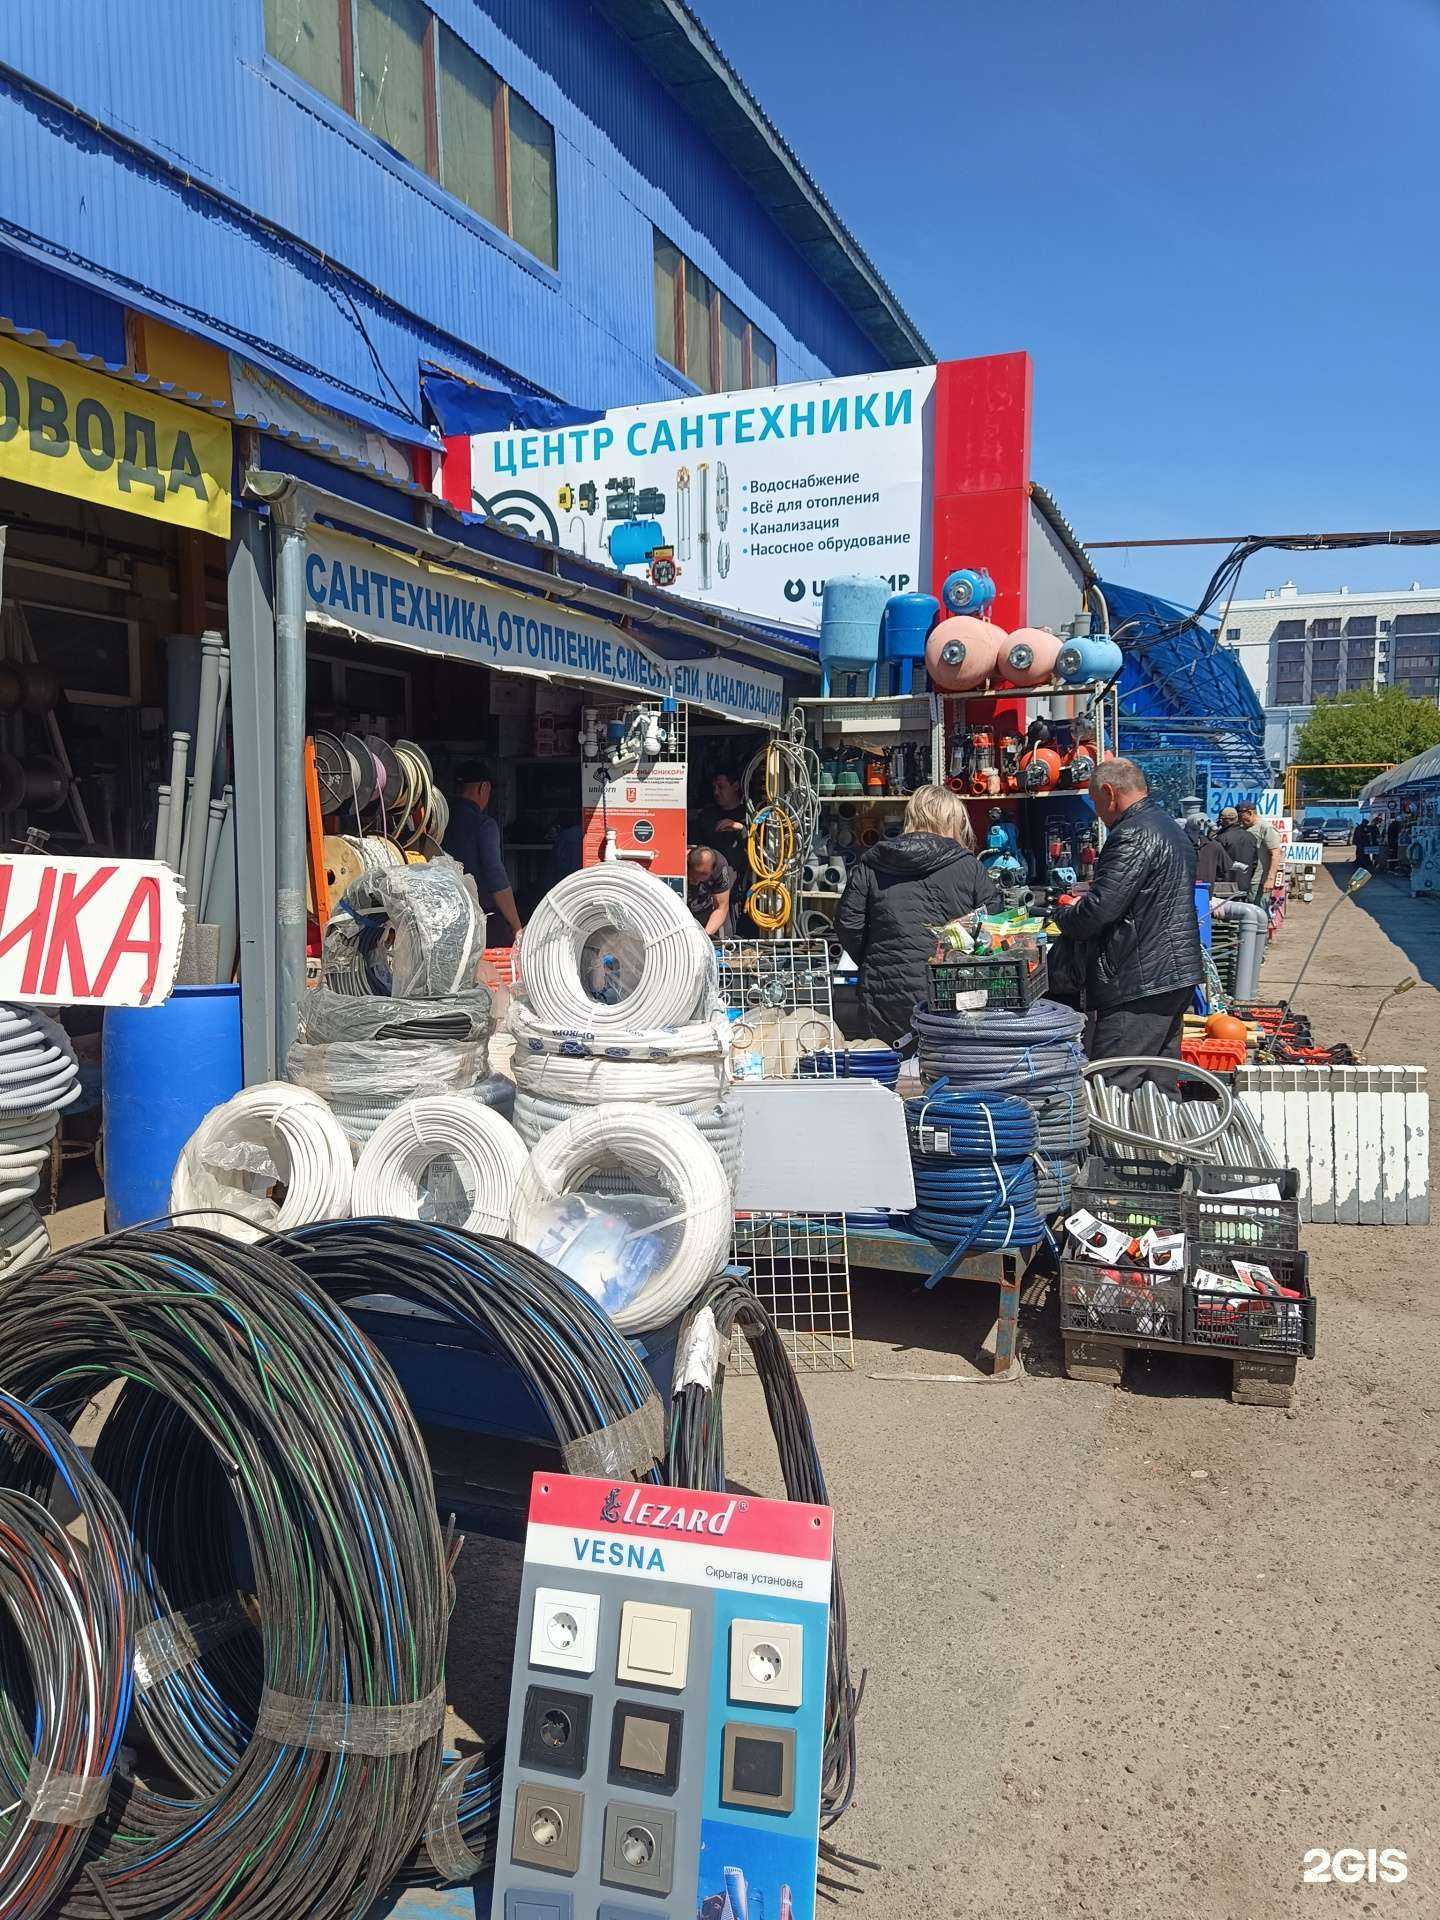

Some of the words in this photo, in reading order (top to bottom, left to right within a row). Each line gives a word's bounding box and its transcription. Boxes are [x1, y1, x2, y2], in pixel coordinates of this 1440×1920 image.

[494, 427, 614, 476] ЦЕНТР
[627, 388, 912, 457] САНТЕХНИКИ
[750, 472, 860, 493] Водоснабжение
[750, 500, 773, 514] Всё
[777, 500, 802, 513] для
[806, 492, 880, 508] отопления
[750, 518, 839, 535] Канализация
[750, 541, 814, 556] Насосное
[818, 533, 911, 553] обрудование
[707, 672, 781, 718] КАНАЛИЗАЦИЯ
[573, 1537, 665, 1572] VESNA
[705, 1565, 748, 1582] Скрытая
[751, 1574, 803, 1589] установка
